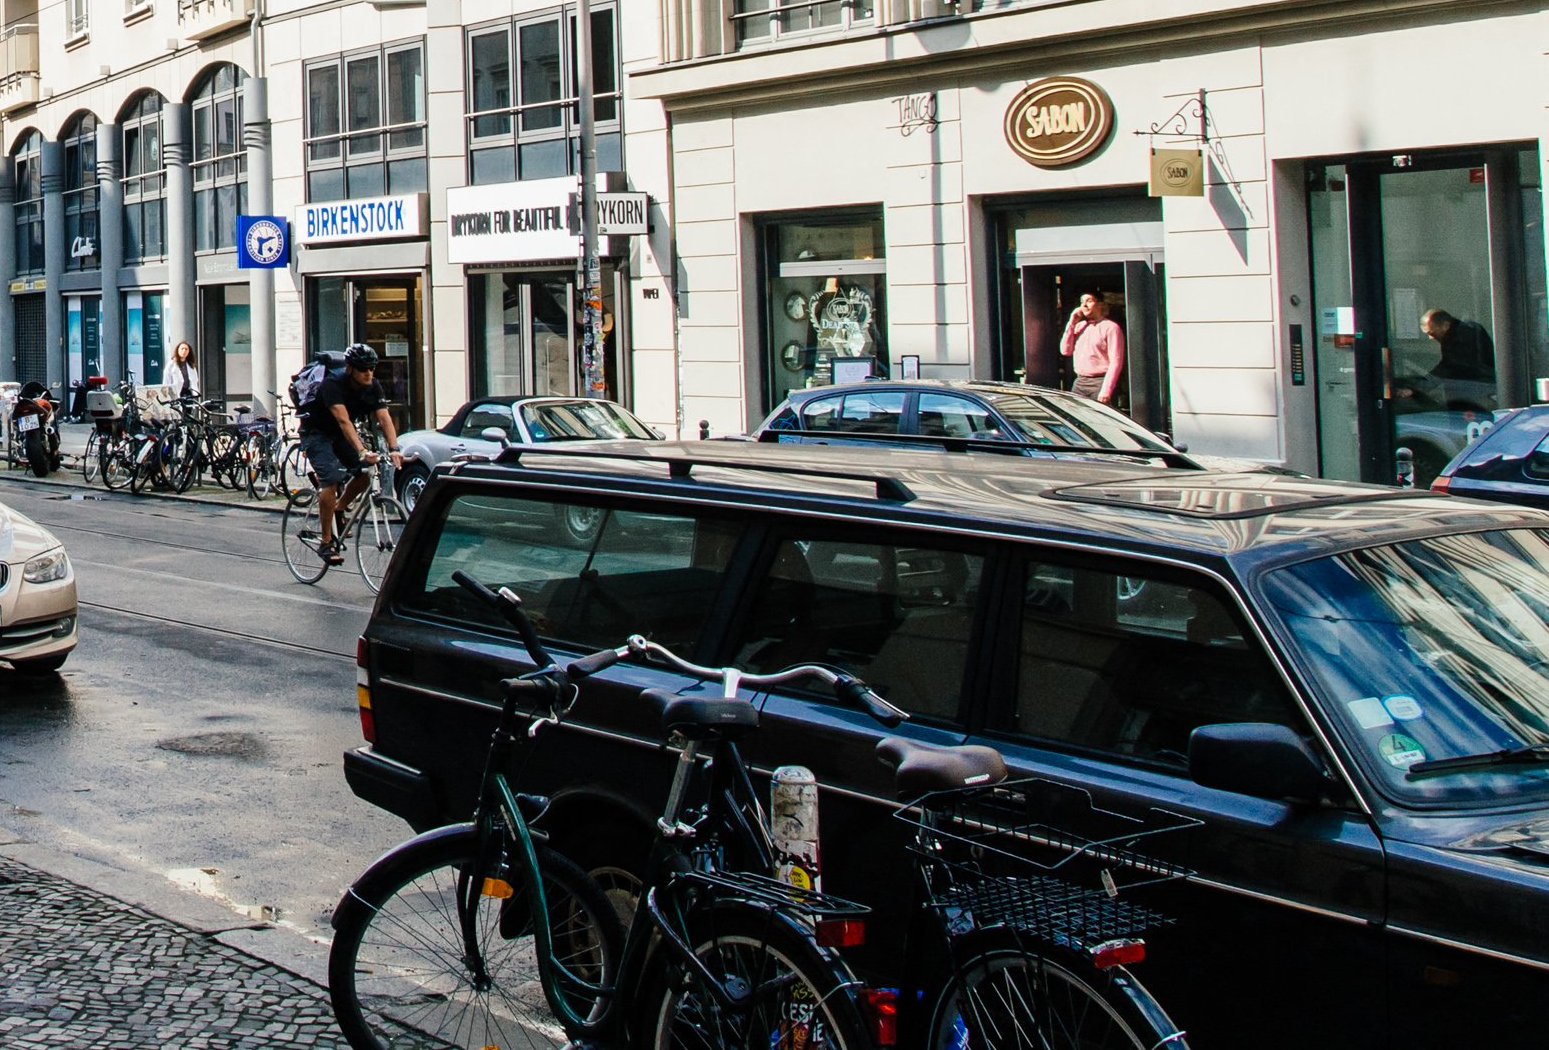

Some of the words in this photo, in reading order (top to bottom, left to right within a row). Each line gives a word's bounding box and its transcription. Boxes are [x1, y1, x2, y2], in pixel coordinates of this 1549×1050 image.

[891, 94, 937, 124] TANGO
[1025, 102, 1085, 138] SABON
[1167, 166, 1188, 179] SABON
[307, 200, 404, 237] BIRKENSTOCK
[494, 210, 511, 234] FOR
[596, 200, 643, 224] RYKORN
